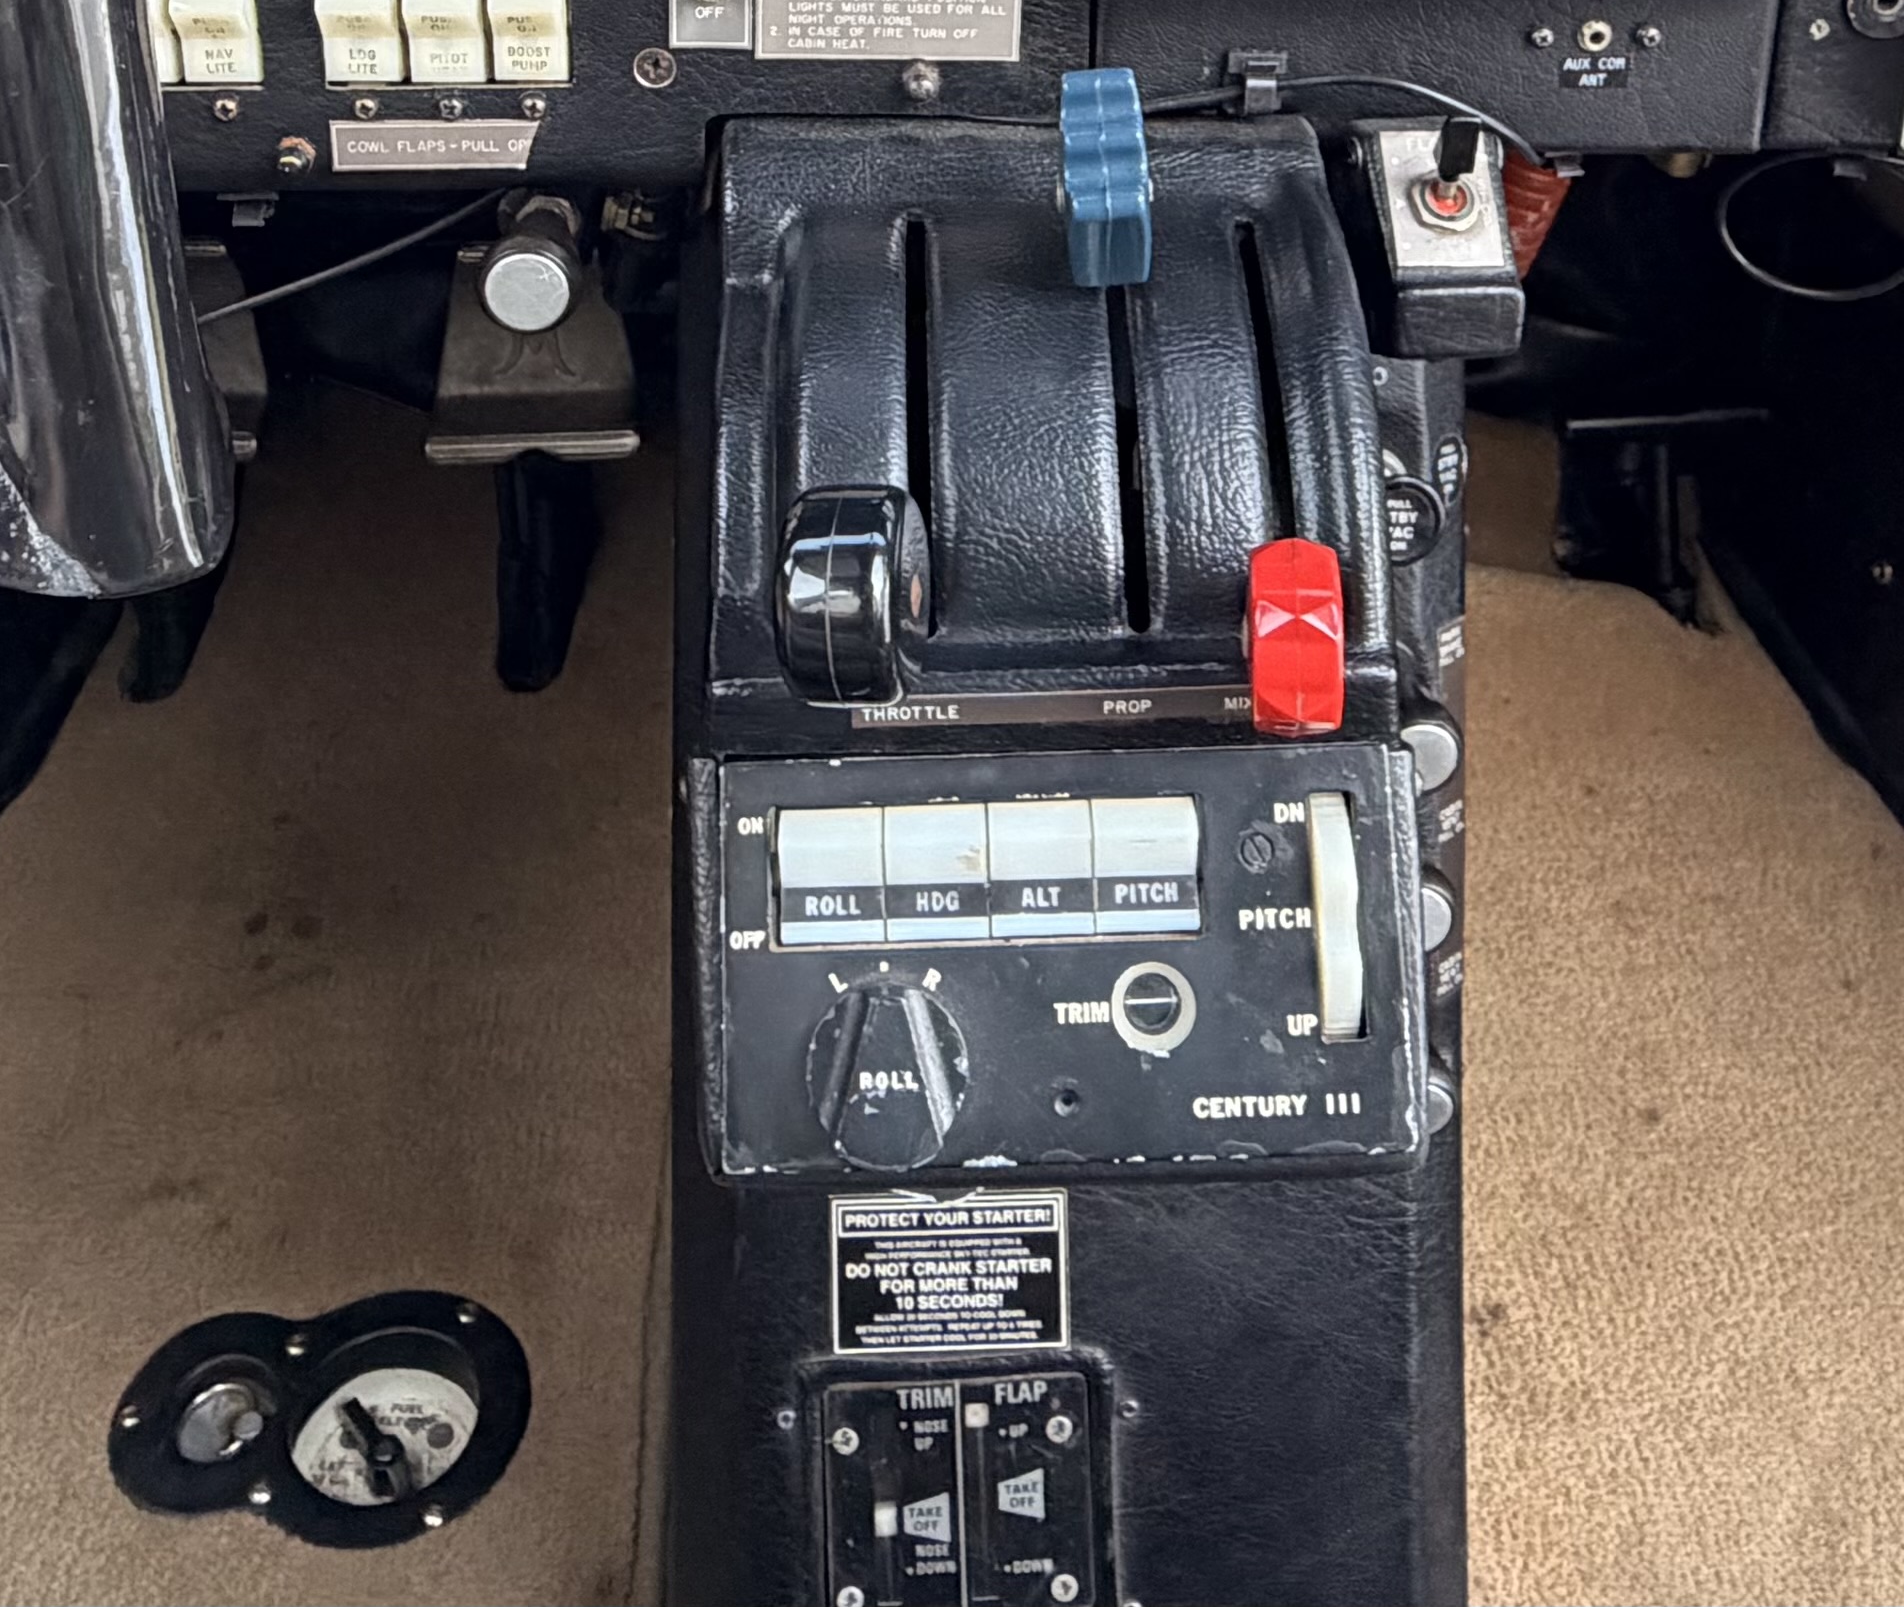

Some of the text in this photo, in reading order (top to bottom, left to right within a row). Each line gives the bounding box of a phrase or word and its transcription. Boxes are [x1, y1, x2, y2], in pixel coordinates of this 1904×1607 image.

[695, 7, 724, 18] OFF
[347, 139, 500, 154] COWL PULL
[862, 698, 1152, 722] THROTTLE PROP
[1274, 804, 1305, 823] DN
[805, 883, 1178, 916] ROLL HDG ALT PITCH
[1239, 909, 1312, 930] PITCH
[1054, 1002, 1110, 1024] TRIM
[1193, 1093, 1361, 1118] CENTURY III
[845, 1209, 1050, 1229] PROTECT YOUR STARTER!
[845, 1258, 1051, 1278] DO NOT CRANK STARTER
[880, 1276, 1017, 1294] FOR MORE THAN
[896, 1293, 1004, 1310] 10 SECONDS!
[897, 1382, 1047, 1410] TRIM FLAP
